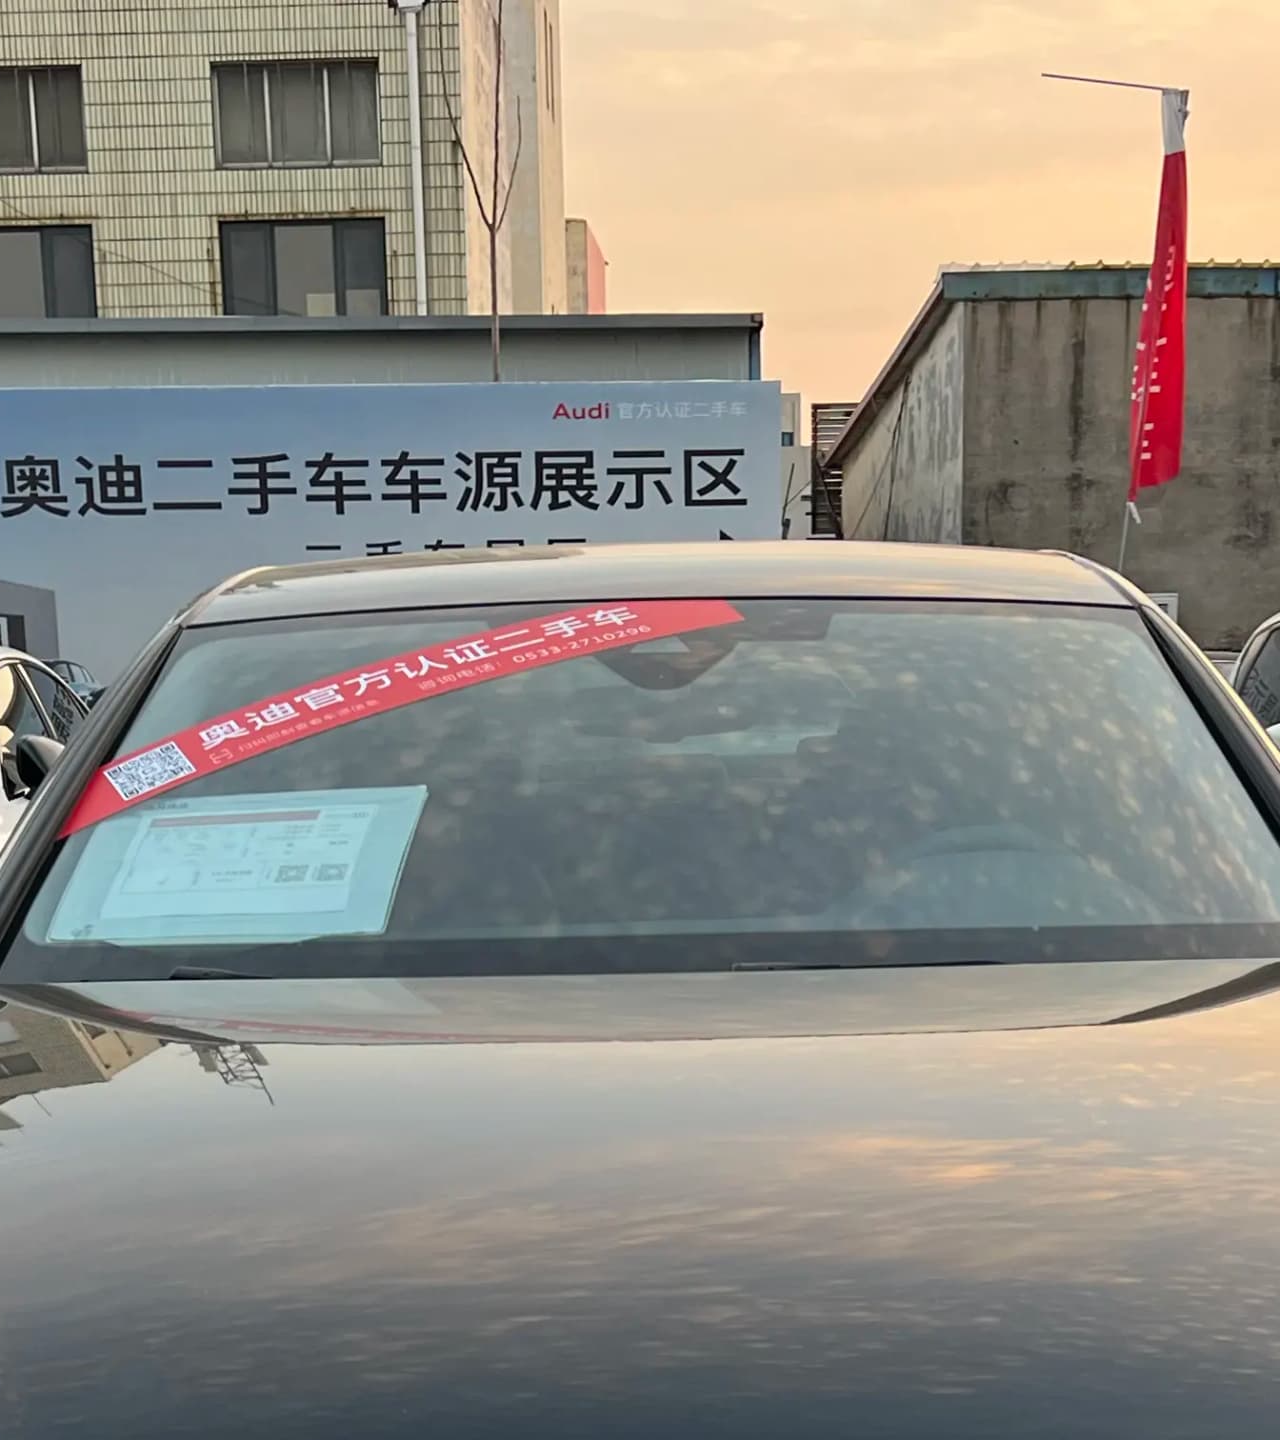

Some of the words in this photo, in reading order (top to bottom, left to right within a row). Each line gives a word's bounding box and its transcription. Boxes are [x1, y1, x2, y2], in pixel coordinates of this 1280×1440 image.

[552, 402, 610, 420] Audi
[617, 401, 748, 419] 官方认证二手车
[0, 448, 748, 518] 奥迪二手车车源展示区
[199, 607, 638, 750] 奥迪官方认证二手车
